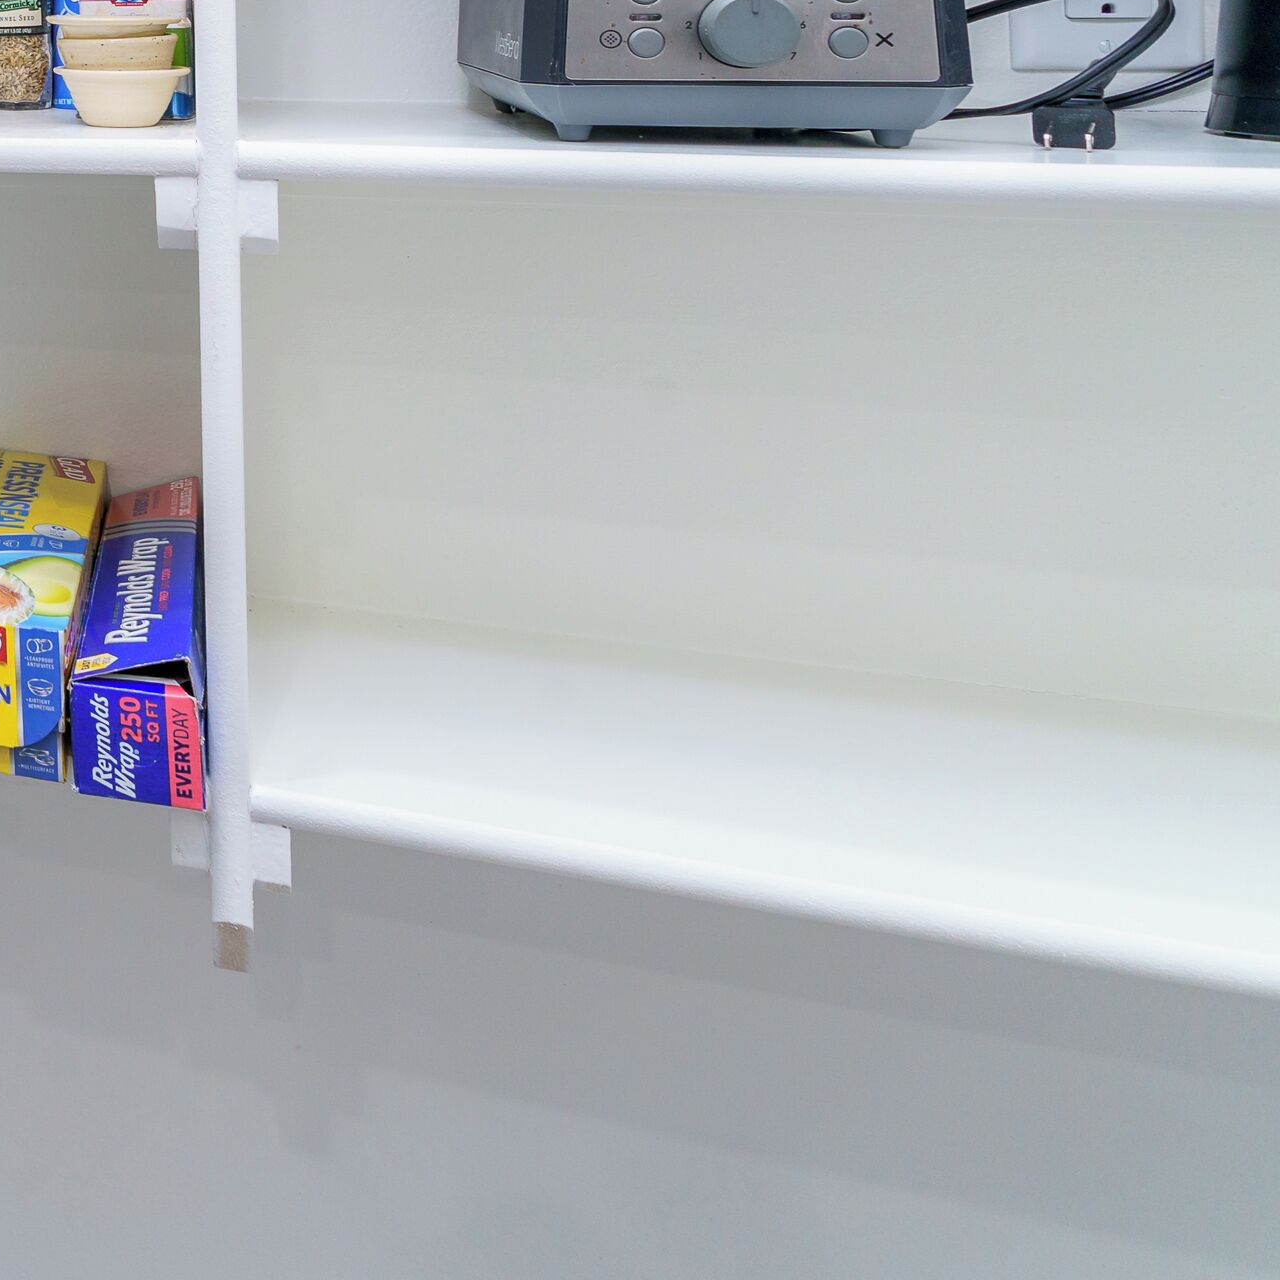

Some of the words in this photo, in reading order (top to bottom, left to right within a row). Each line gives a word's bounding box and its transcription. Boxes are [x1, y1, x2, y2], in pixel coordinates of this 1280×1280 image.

[685, 21, 693, 30] 2
[800, 20, 807, 29] 6
[790, 51, 797, 60] 7
[56, 457, 87, 481] GLAD
[117, 536, 168, 571] Wrap
[104, 567, 163, 644] Reynolds
[26, 656, 54, 664] LEAKPROOF
[119, 696, 142, 744] 250
[145, 699, 159, 720] FT
[91, 692, 110, 791] Reynolds
[146, 723, 160, 744] SQ
[171, 707, 193, 800] EVERYDAY
[20, 764, 55, 774] MULTISURFACE
[115, 738, 140, 799] Wrap
